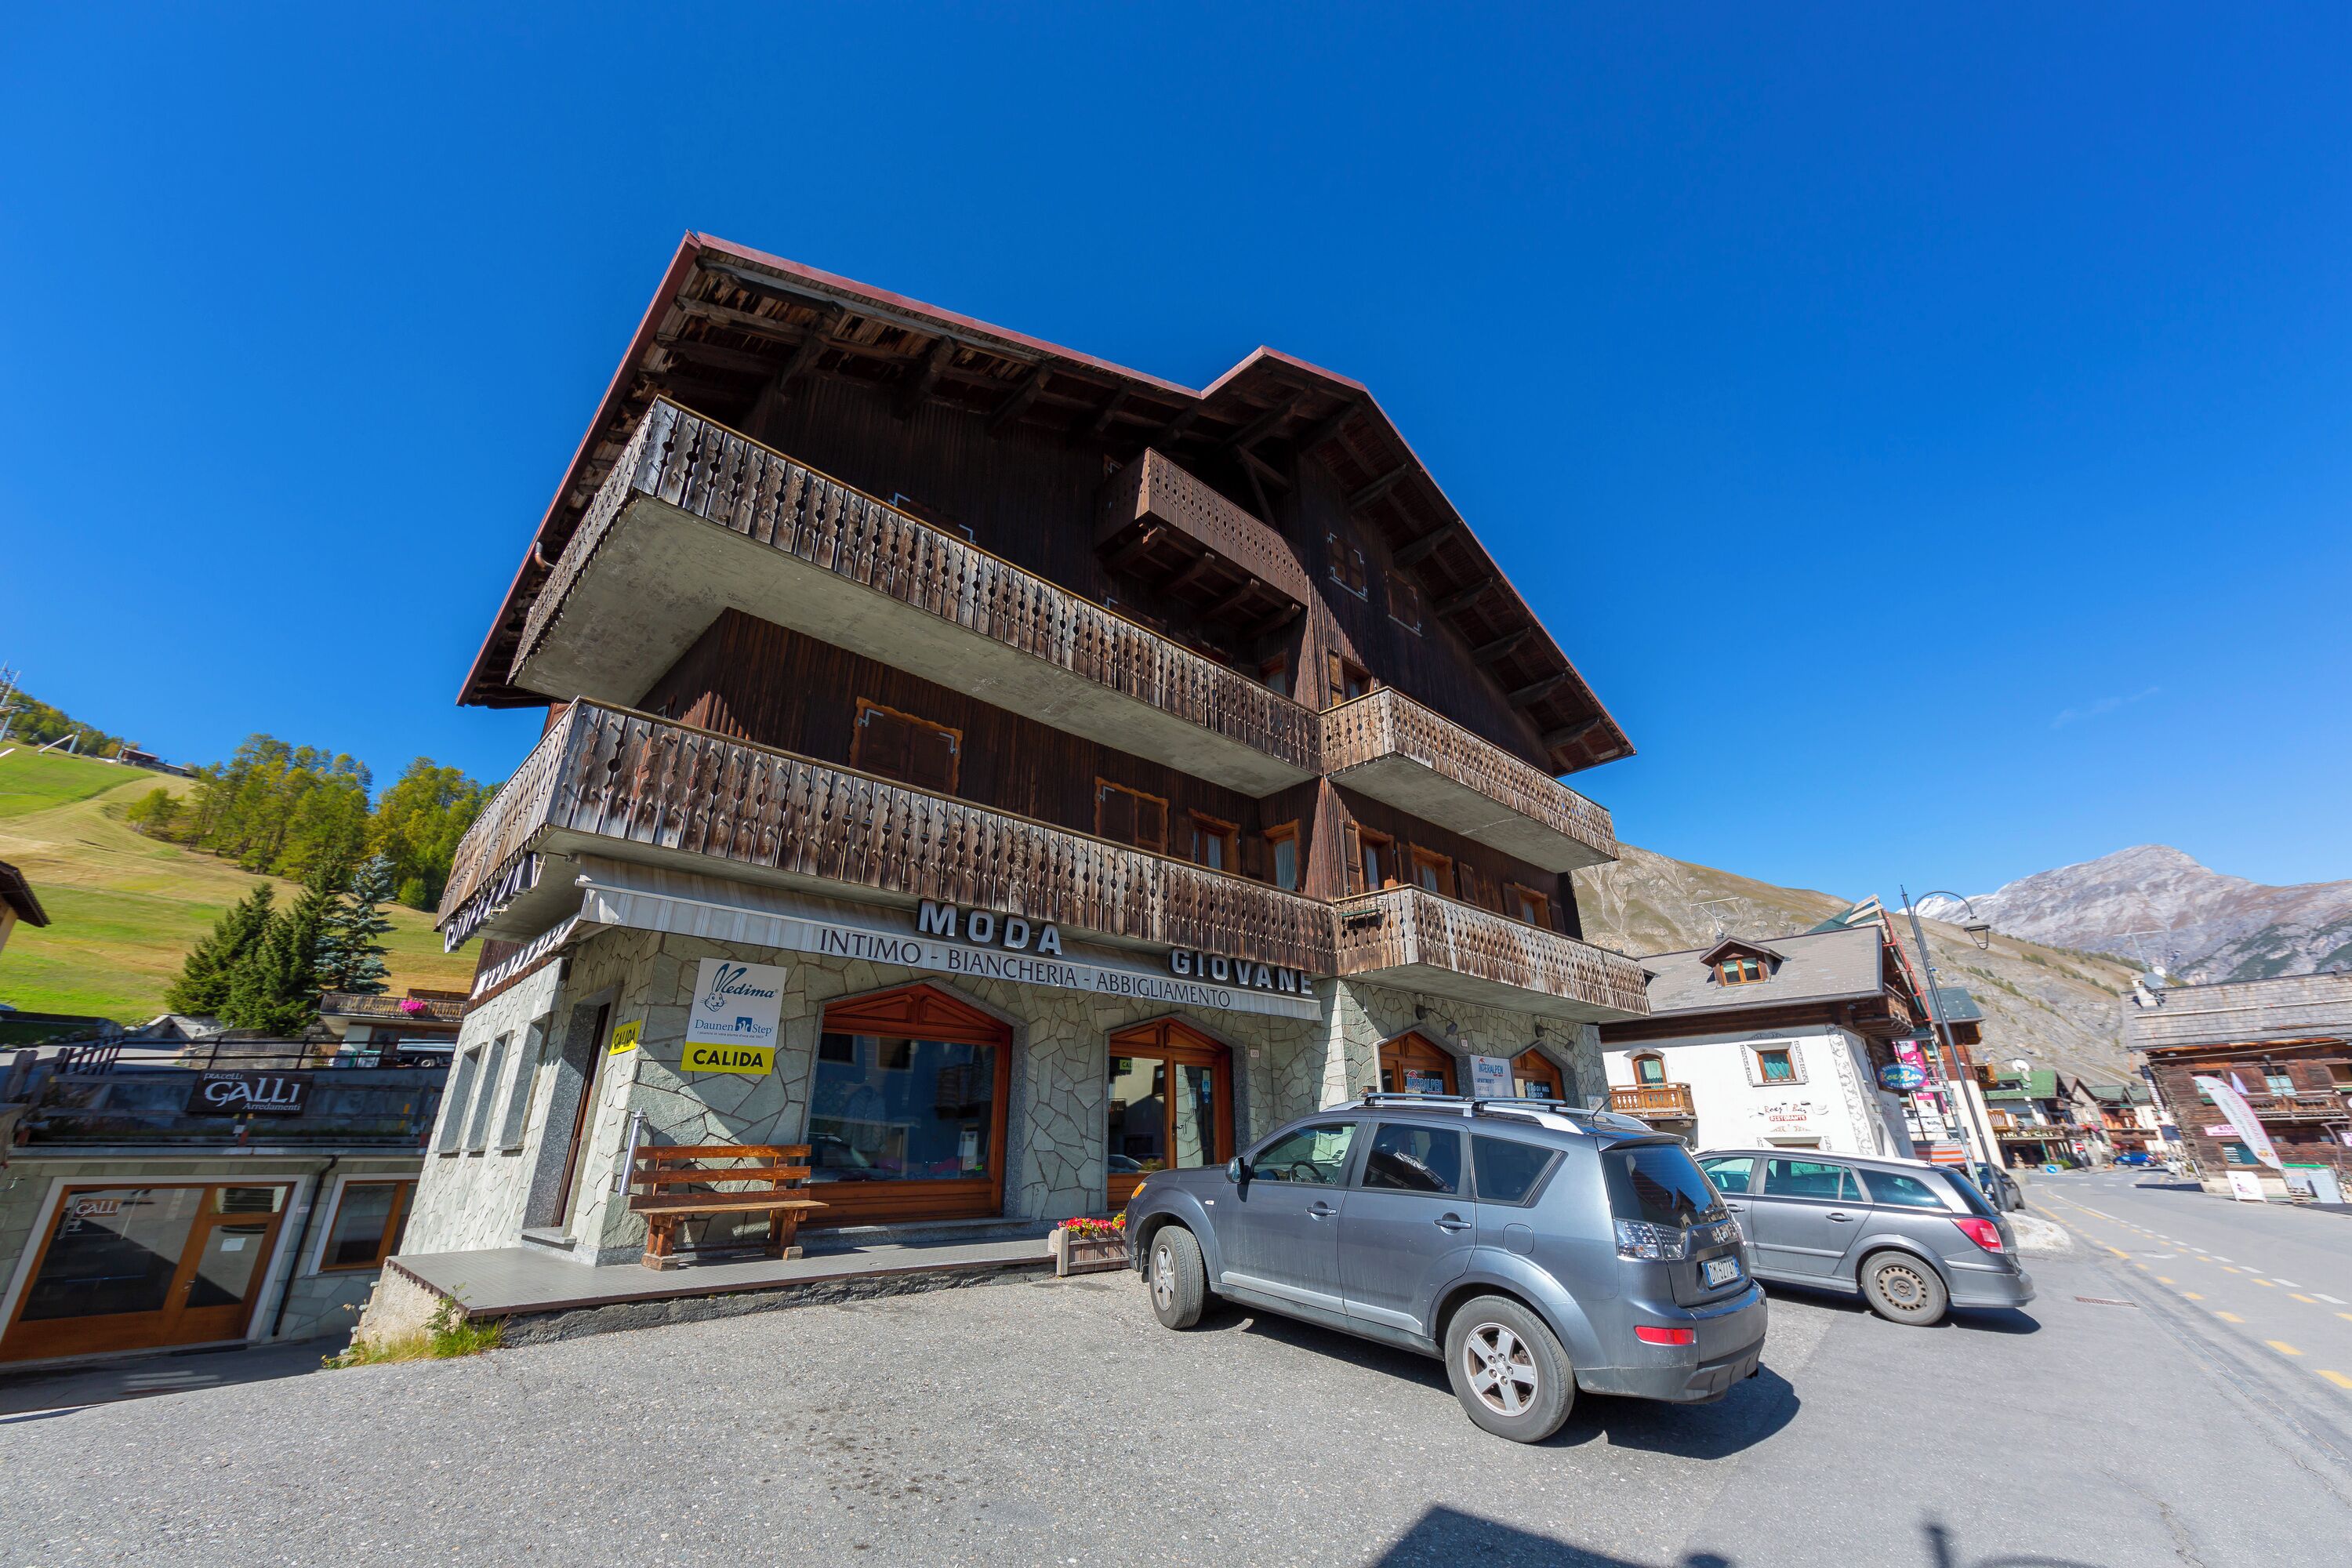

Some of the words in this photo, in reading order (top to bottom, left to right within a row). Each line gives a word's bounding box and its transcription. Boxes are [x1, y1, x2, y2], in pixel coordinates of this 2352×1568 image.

[918, 900, 1062, 956] MODA
[1171, 948, 1313, 996] GIOVANE
[820, 928, 921, 964] INTIMO
[948, 949, 1078, 987] BIANCHERIA
[1096, 972, 1231, 1008] ABBIGLIAMENTO
[695, 1019, 734, 1032] Daunen
[752, 1023, 772, 1036] Step
[614, 1028, 636, 1048] CALIDA
[693, 1049, 764, 1068] CALIDA
[204, 1073, 243, 1081] FRATELLI
[1478, 1063, 1504, 1074] INTERALPEN
[204, 1077, 301, 1107] GALLI
[1406, 1077, 1443, 1093] INTERALPEN
[242, 1102, 301, 1111] Arredamenti
[75, 1200, 121, 1218] GALLI
